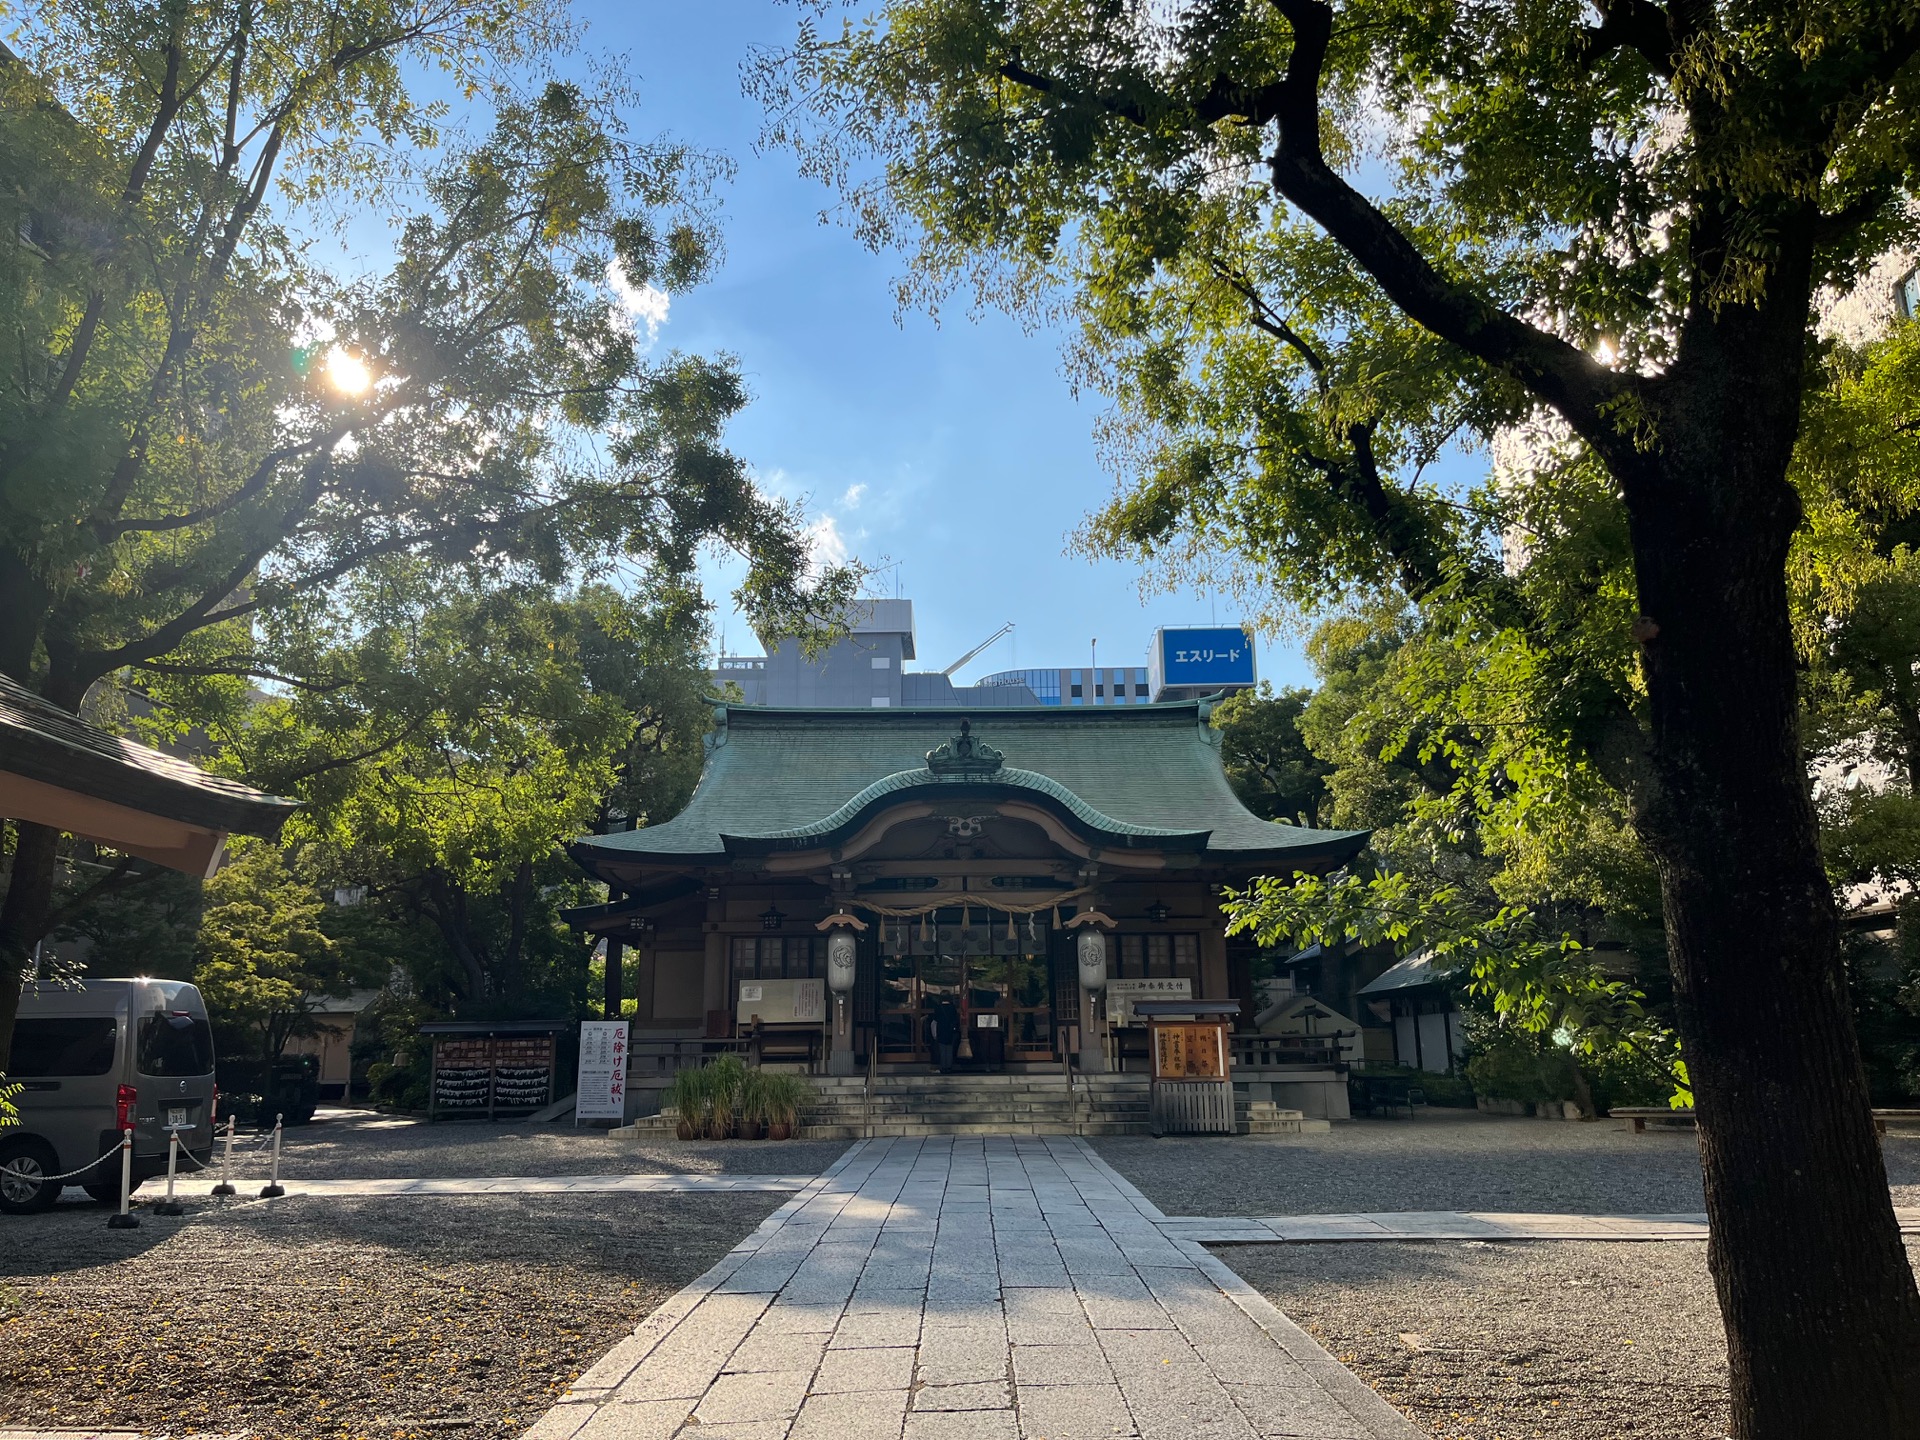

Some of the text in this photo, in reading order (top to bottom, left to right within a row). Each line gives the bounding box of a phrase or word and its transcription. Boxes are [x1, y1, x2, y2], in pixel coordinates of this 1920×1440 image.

[1175, 649, 1240, 663] エスリード
[611, 1027, 626, 1105] 厄除け厄祓い
